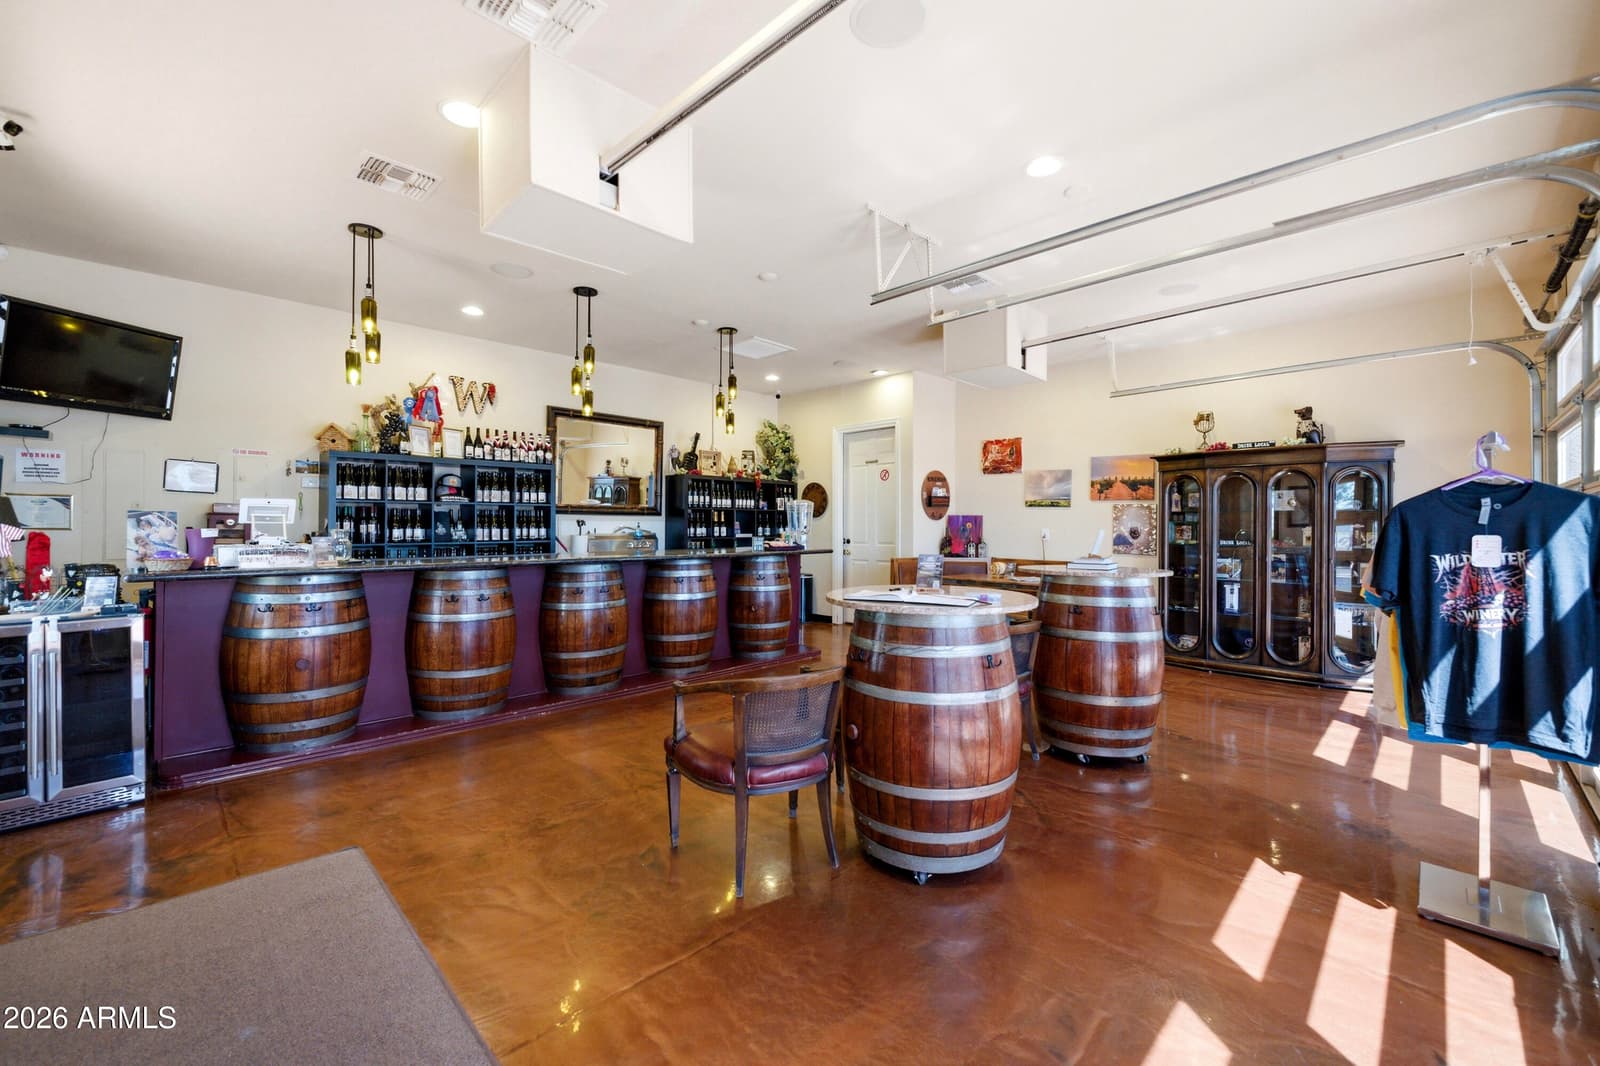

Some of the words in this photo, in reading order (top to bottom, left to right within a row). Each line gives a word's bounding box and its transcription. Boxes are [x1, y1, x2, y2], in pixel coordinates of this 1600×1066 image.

[449, 375, 496, 415] W
[1430, 549, 1530, 582] WILDTER
[1461, 607, 1520, 625] WINERY
